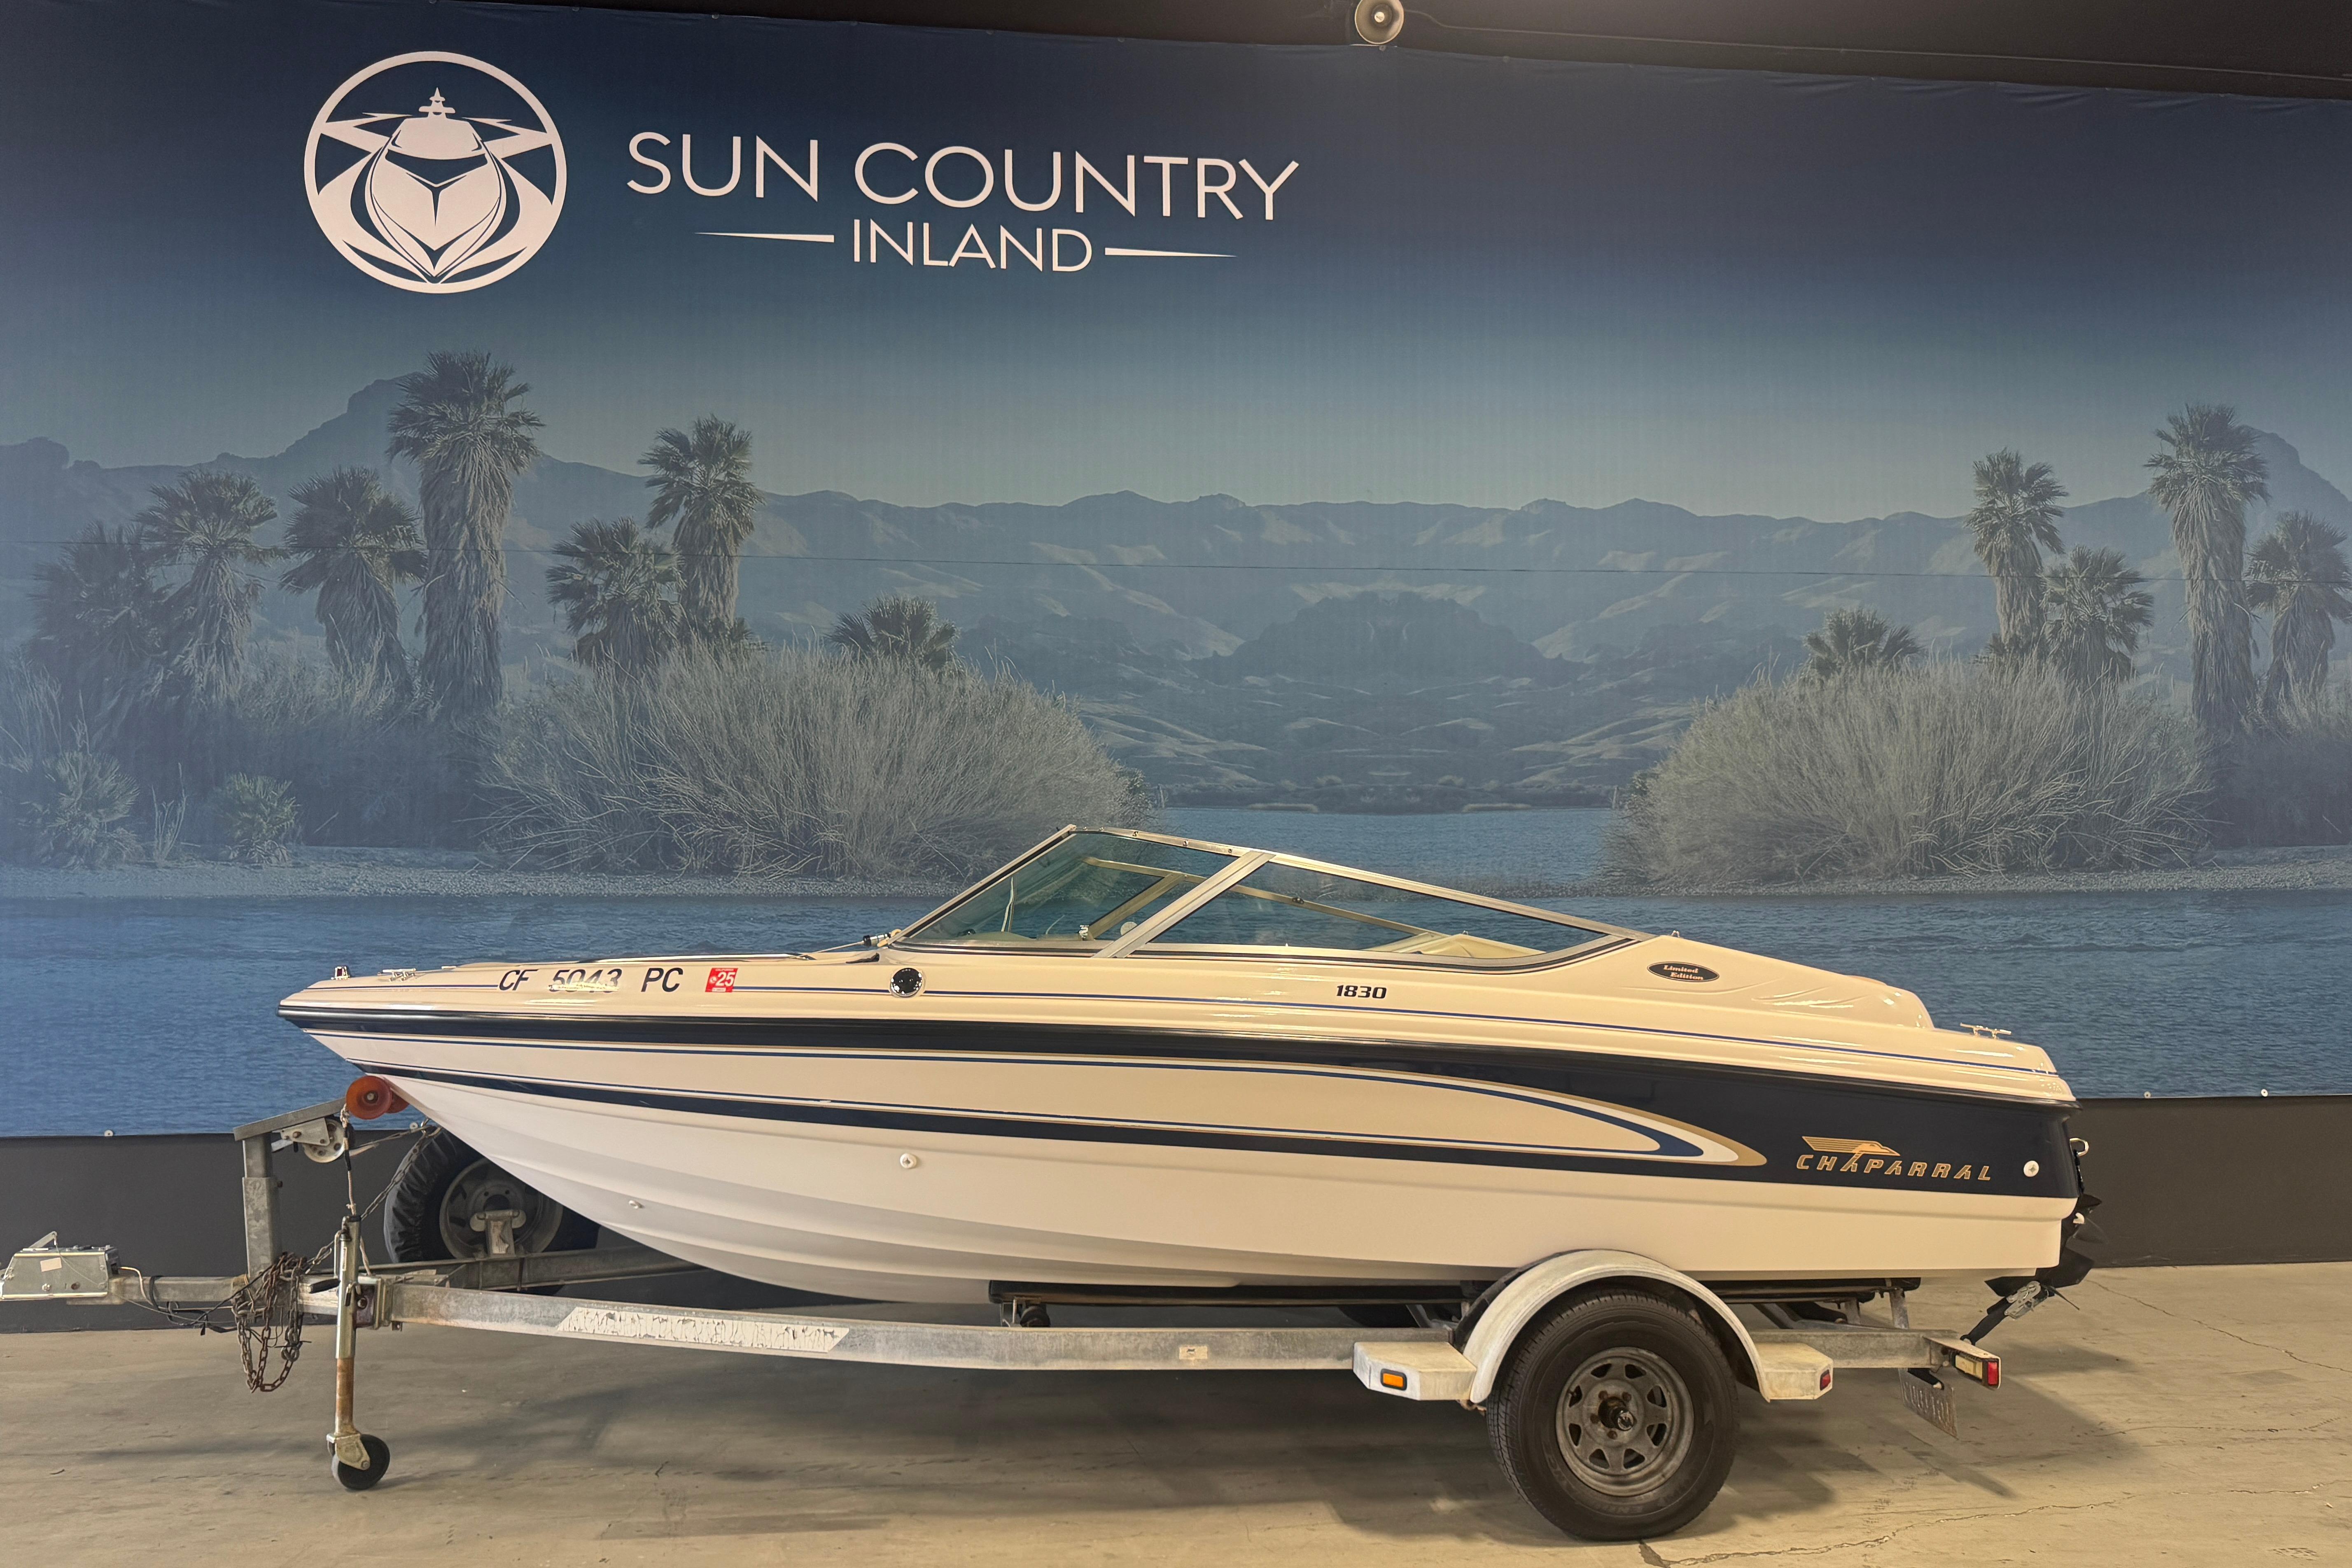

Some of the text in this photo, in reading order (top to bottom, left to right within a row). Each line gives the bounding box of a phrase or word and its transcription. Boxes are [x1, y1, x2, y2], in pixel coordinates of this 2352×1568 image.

[627, 132, 1299, 220] SUN COUNTRY
[854, 219, 1092, 272] INLAND
[499, 967, 684, 993] CF 5043 PC
[715, 971, 736, 987] 25
[1664, 965, 1698, 973] Limited
[1336, 985, 1387, 999] 1830
[1796, 1153, 1991, 1181] CHAPARRAL
